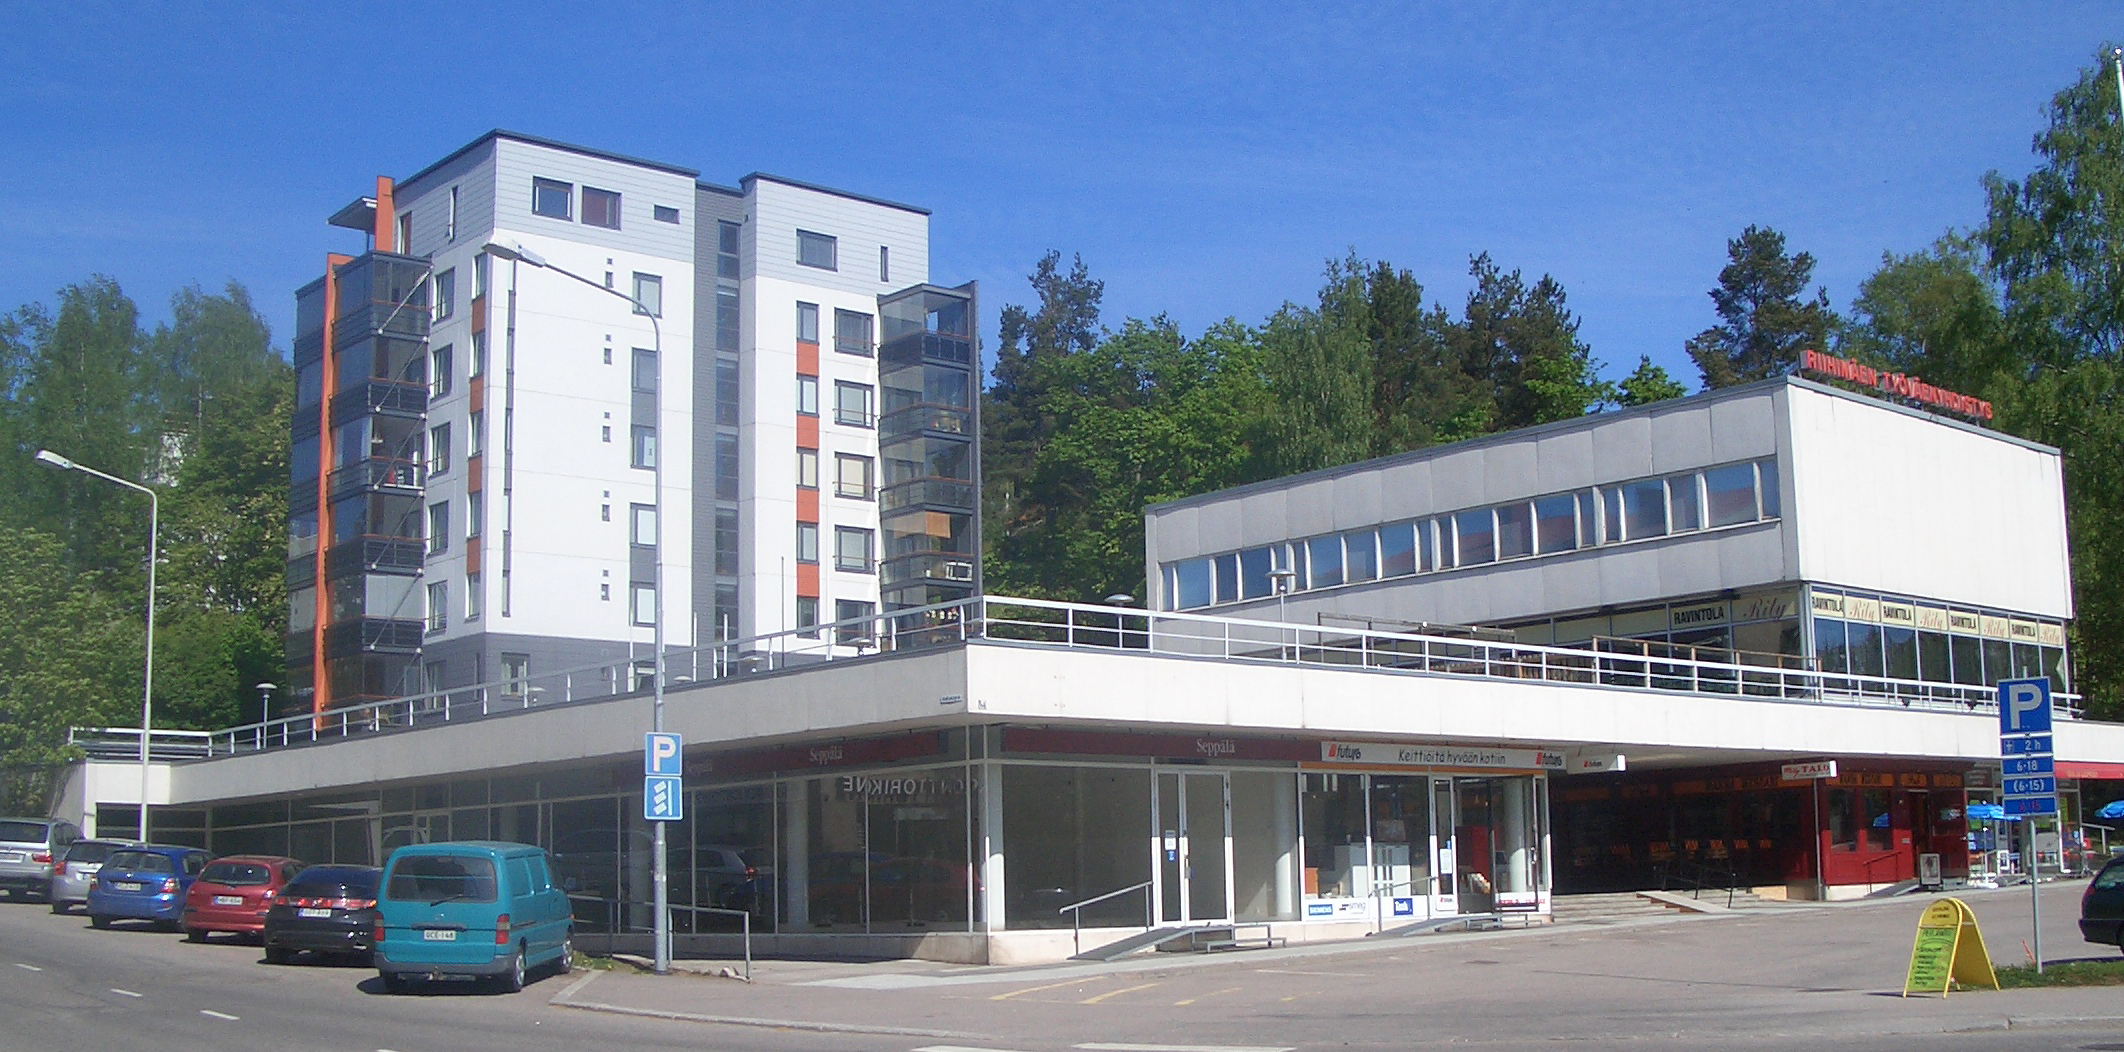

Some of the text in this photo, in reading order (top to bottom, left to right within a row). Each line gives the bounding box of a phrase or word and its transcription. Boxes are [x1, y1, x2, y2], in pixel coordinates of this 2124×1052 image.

[1806, 349, 1877, 388] RIIHIMÄEN
[1674, 606, 1725, 625] RAVINTOLA
[2008, 683, 2043, 730] P
[653, 736, 677, 773] P
[1196, 738, 1235, 757] Seppälä
[2025, 739, 2041, 751] 2 h
[810, 746, 843, 765] Seppälä
